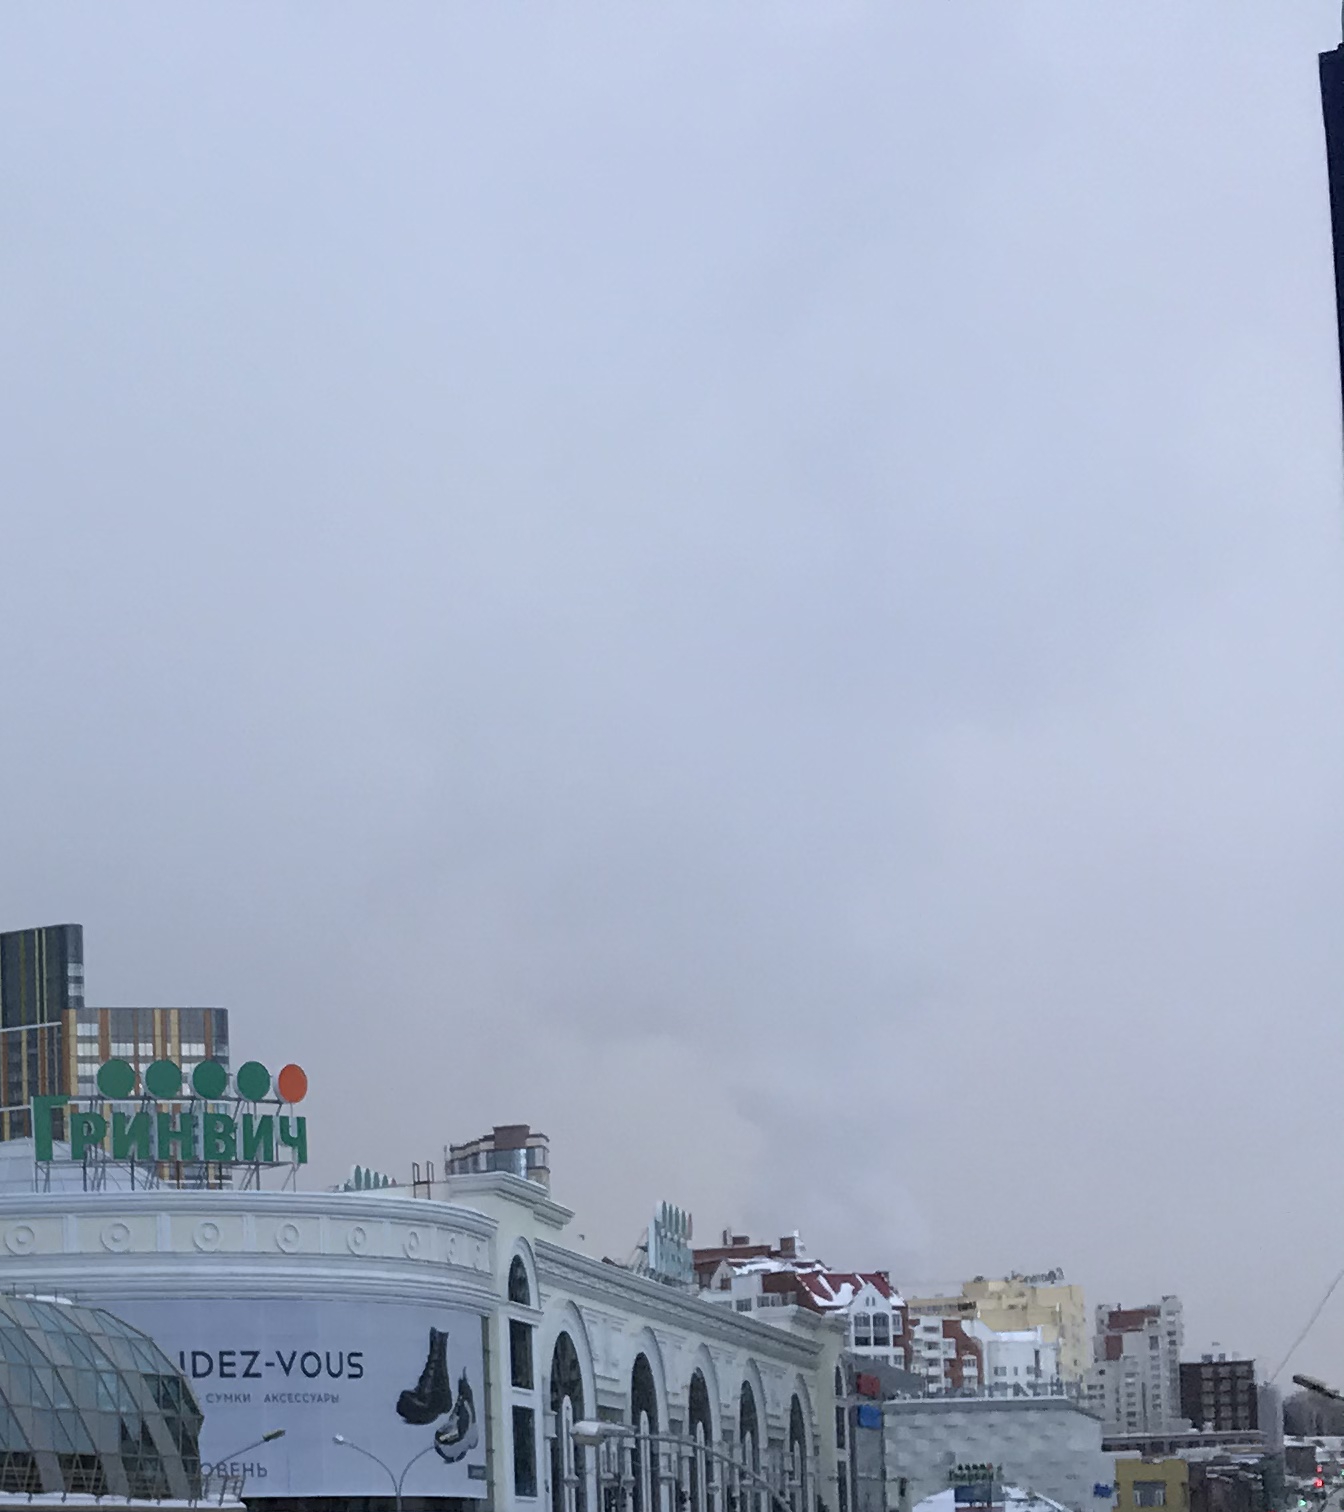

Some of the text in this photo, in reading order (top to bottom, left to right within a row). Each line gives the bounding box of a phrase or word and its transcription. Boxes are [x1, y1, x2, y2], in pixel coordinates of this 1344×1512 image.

[205, 1392, 340, 1404] СУМКИ АКСЕССУАРЫ
[200, 1462, 268, 1478] ОВЕНЬ
